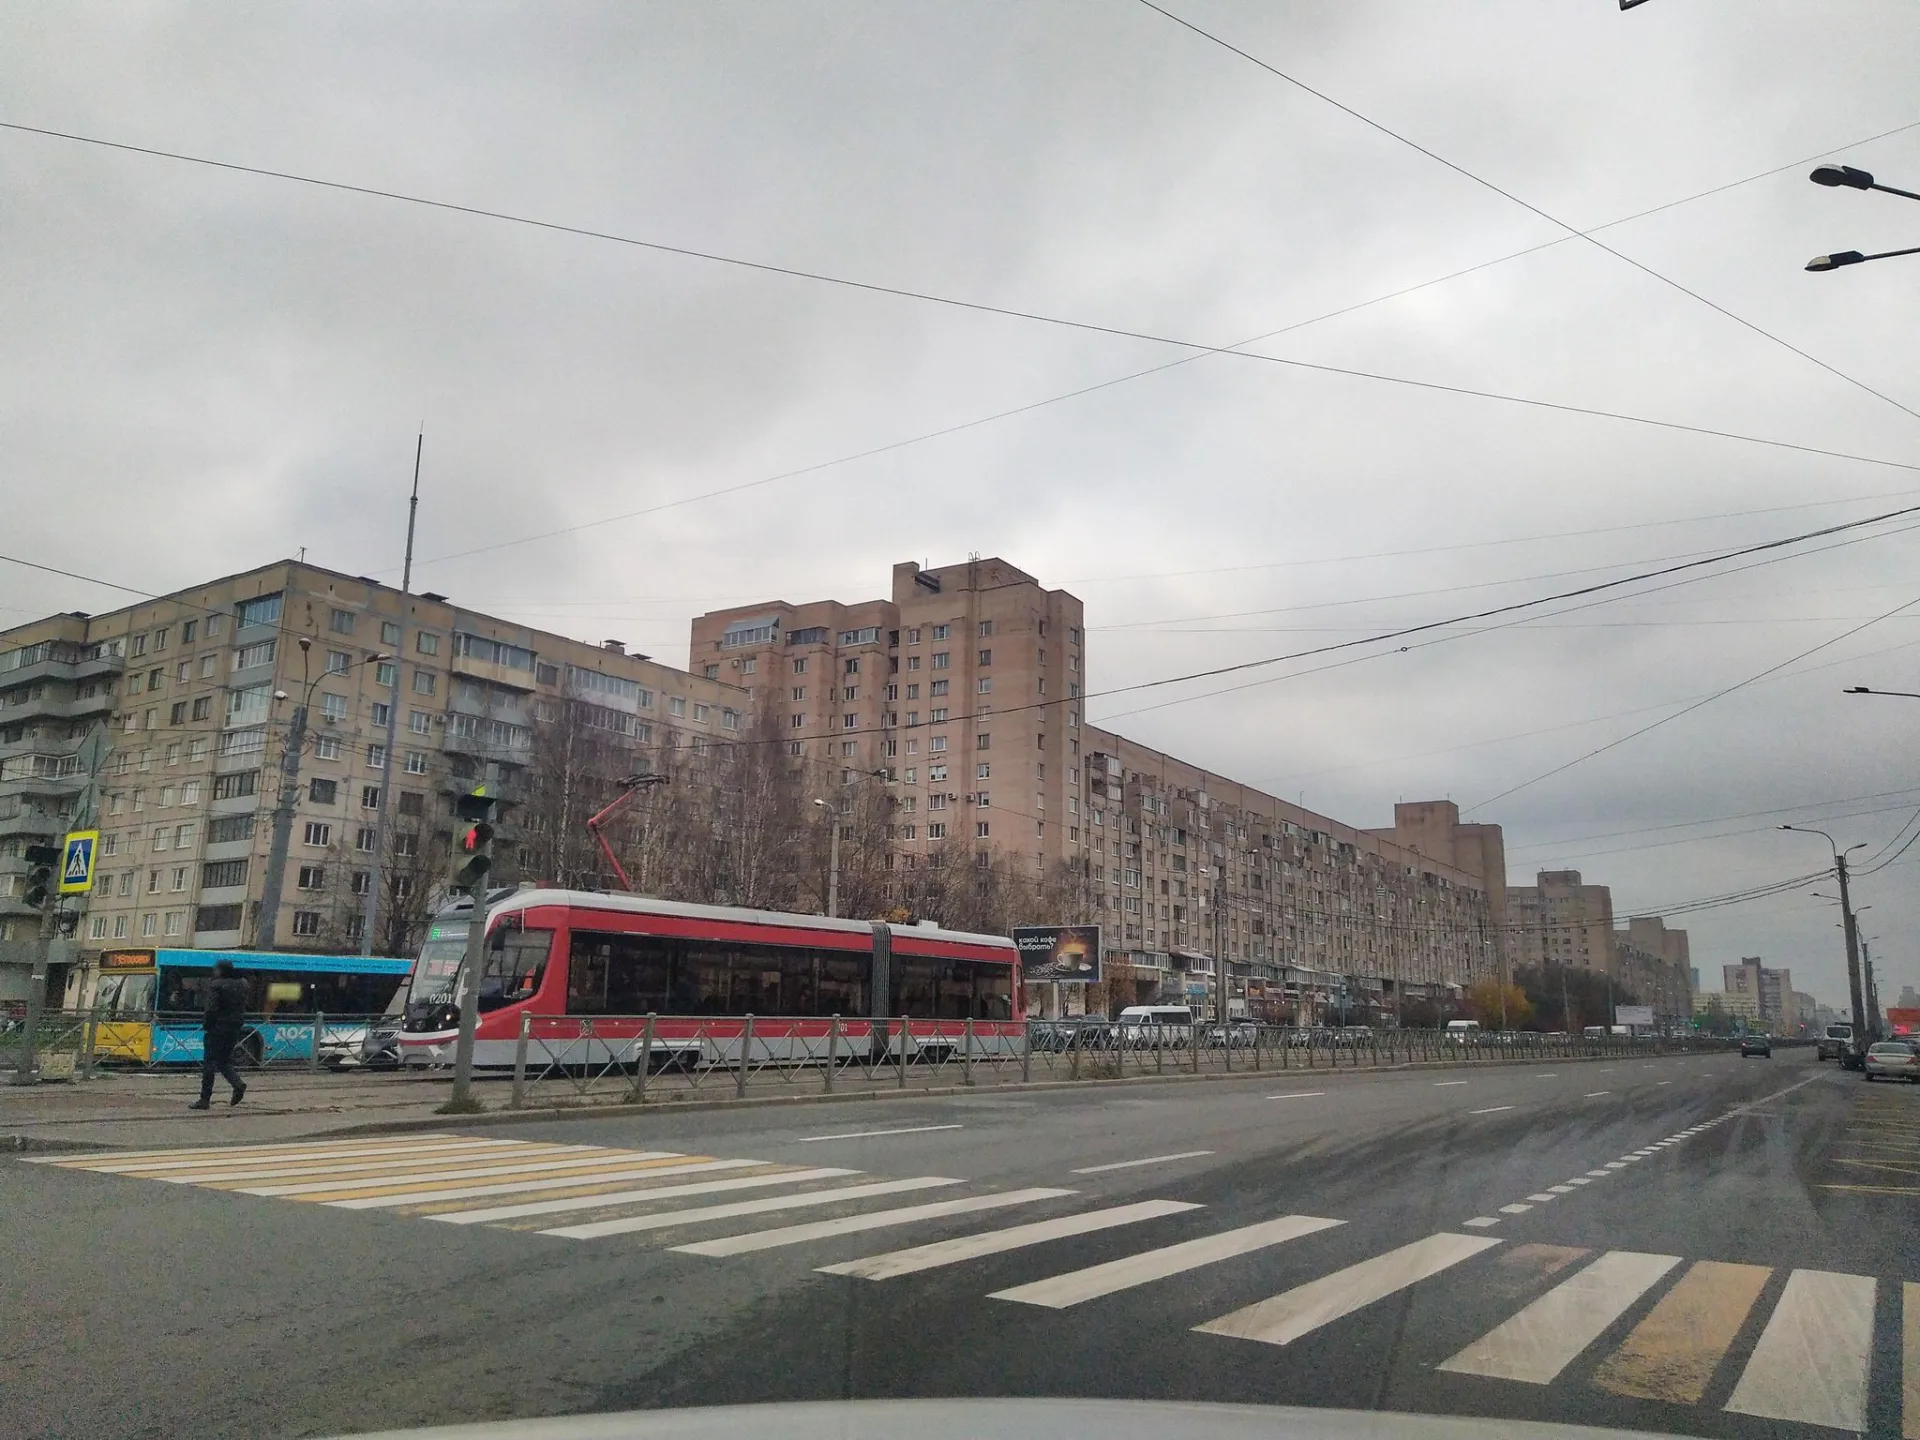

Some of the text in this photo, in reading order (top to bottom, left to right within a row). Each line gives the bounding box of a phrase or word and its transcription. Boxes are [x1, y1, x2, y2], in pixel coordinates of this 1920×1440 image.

[1018, 935, 1057, 944] какой кофе
[1018, 943, 1054, 951] выбрать?
[430, 993, 452, 1004] 0201
